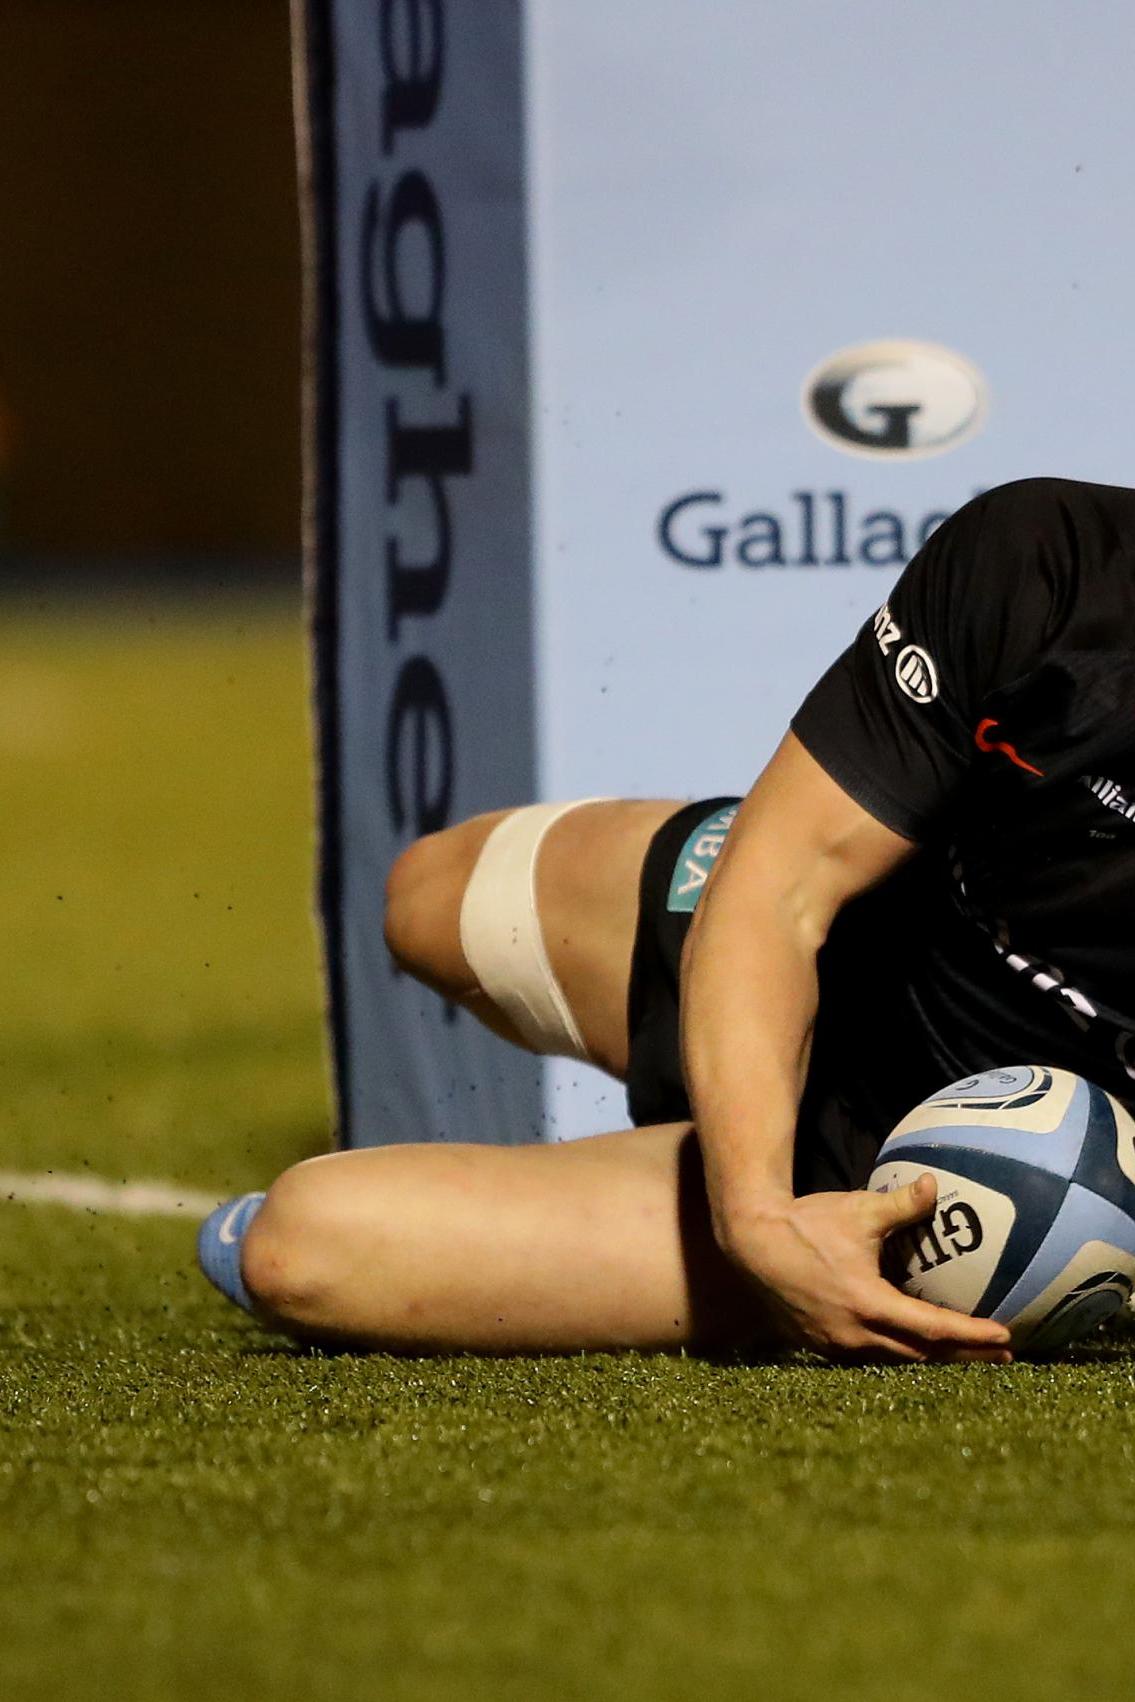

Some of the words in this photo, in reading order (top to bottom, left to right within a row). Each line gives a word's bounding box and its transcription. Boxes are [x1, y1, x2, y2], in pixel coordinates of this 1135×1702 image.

[360, 0, 474, 1028] aghe
[656, 489, 986, 571] Galla
[873, 601, 901, 656] nz
